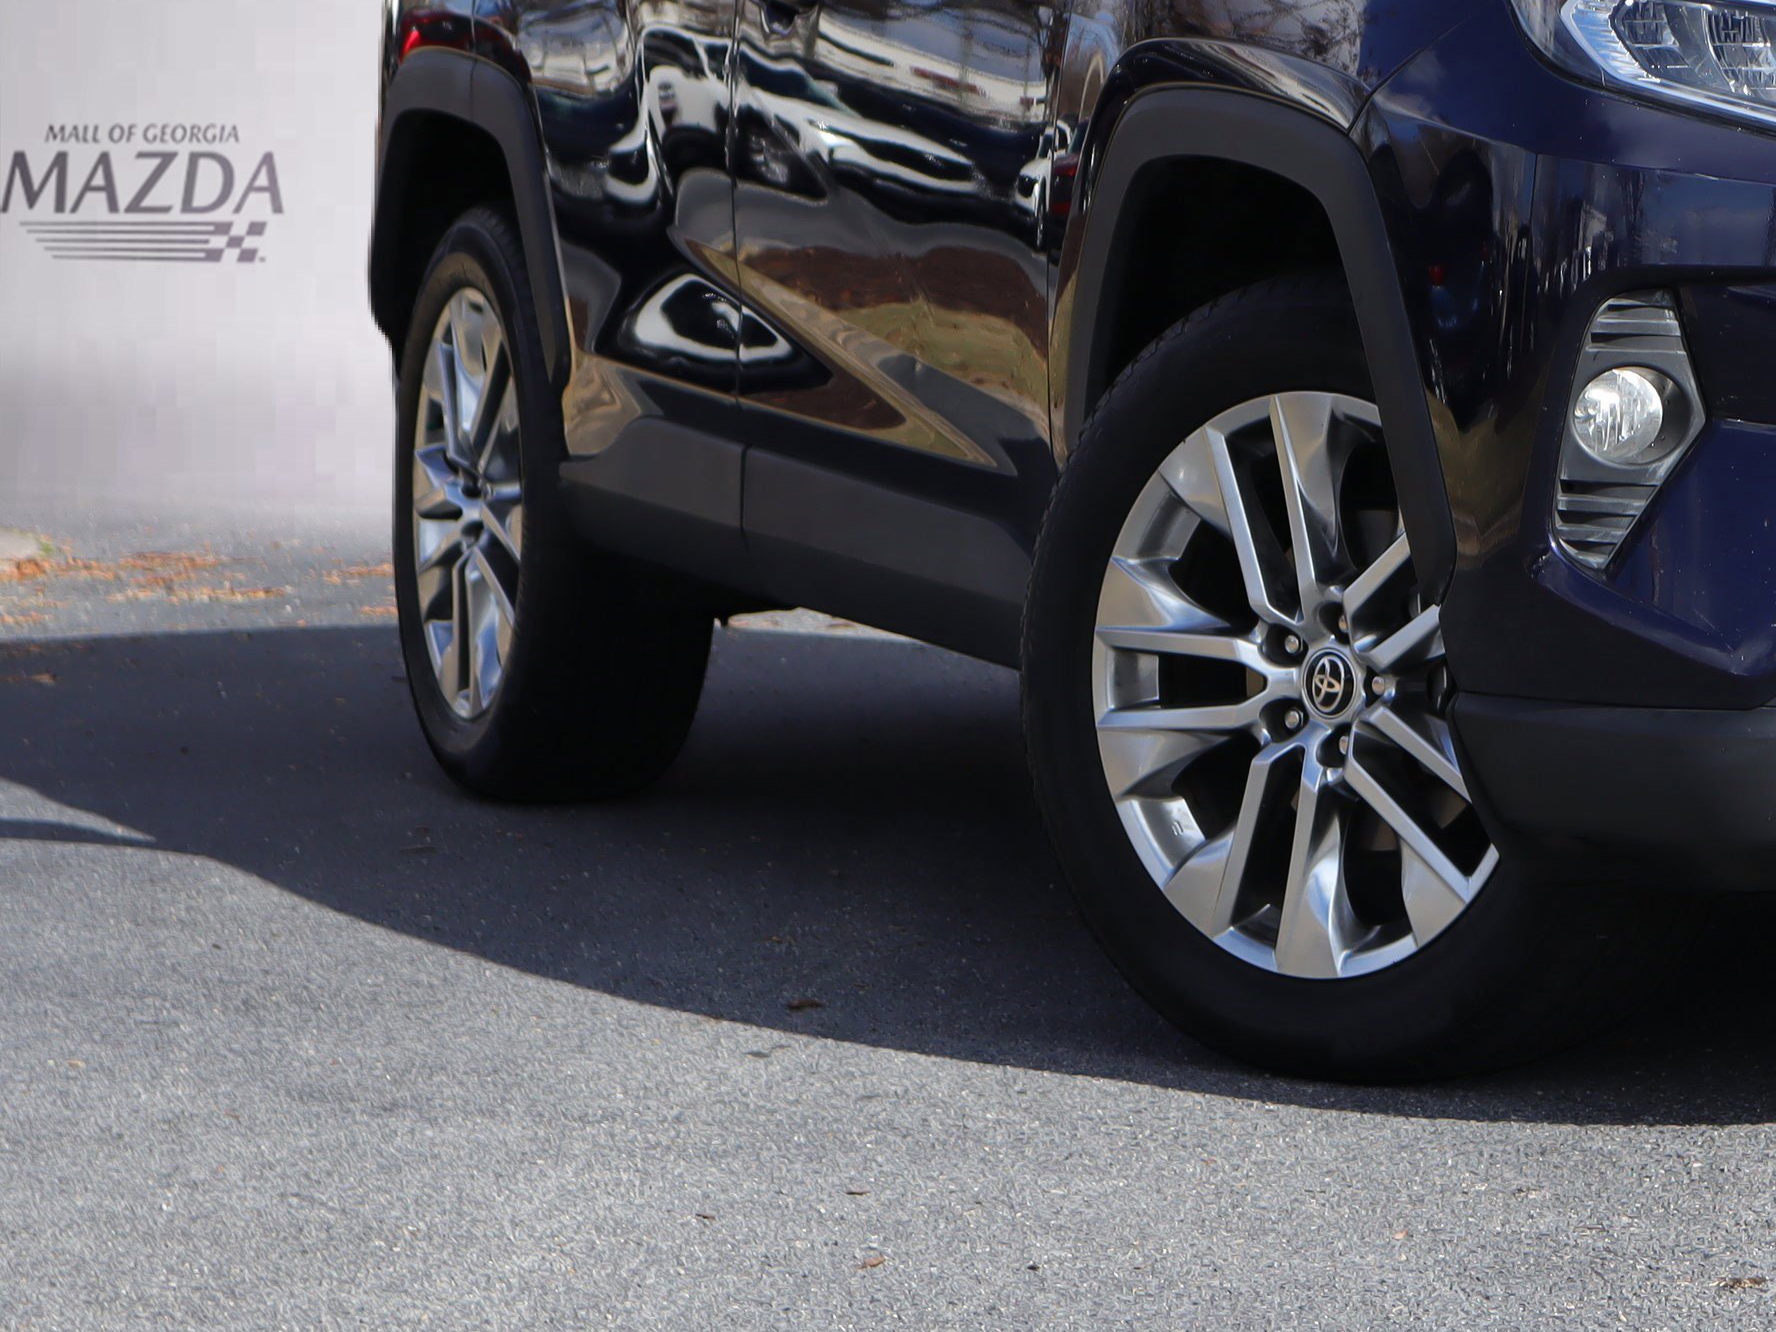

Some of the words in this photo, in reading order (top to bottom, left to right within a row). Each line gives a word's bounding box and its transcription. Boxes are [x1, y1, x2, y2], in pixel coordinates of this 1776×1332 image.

[44, 123, 101, 145] MALL
[108, 123, 137, 145] OF
[143, 123, 240, 145] GEORGIA
[0, 150, 284, 215] MAZDA
